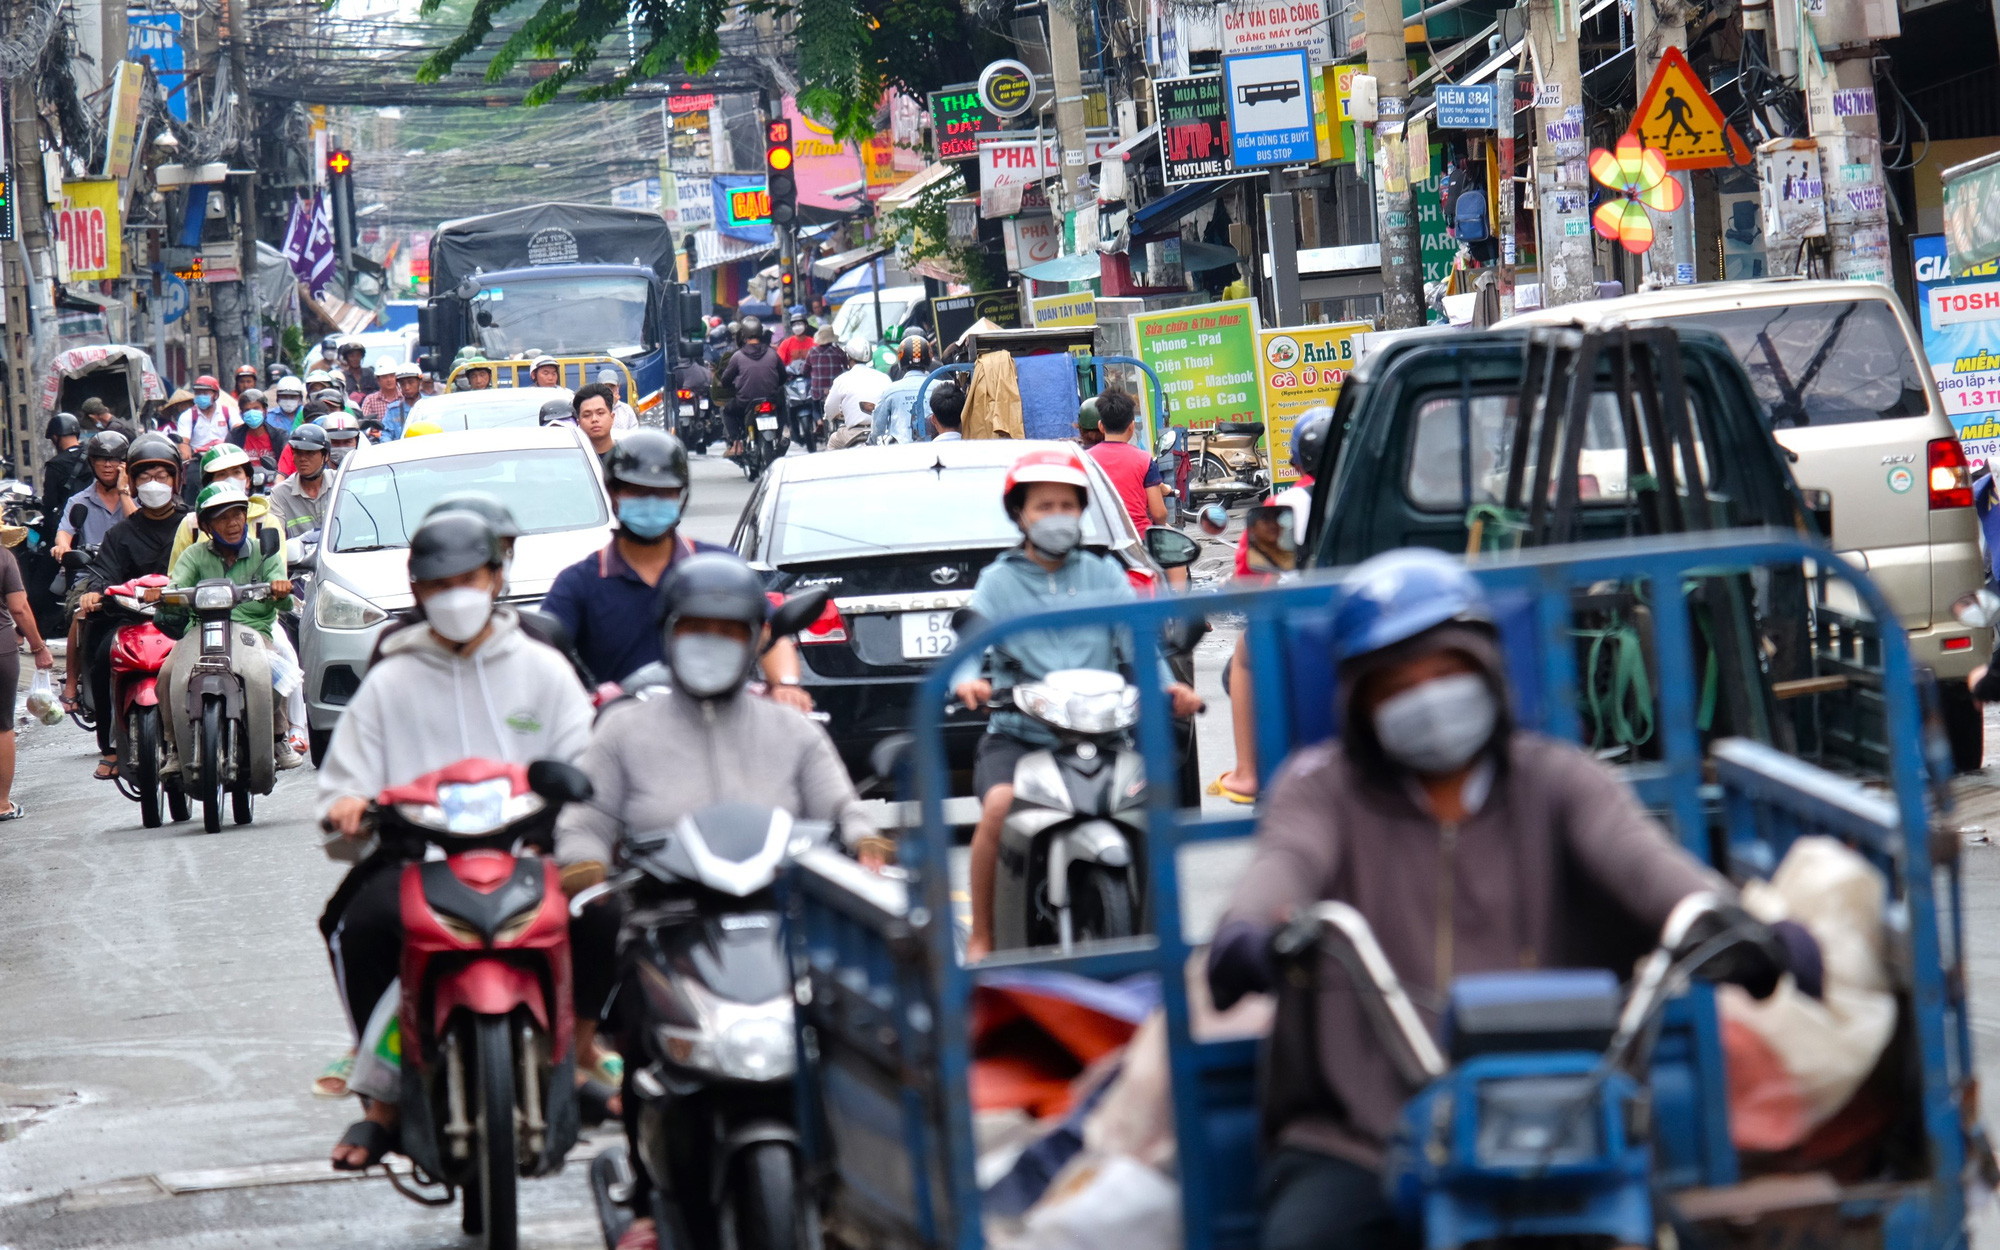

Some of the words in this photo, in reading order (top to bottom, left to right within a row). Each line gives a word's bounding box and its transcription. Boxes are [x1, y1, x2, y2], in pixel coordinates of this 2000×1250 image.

[1269, 8, 1287, 25] GIA
[1290, 2, 1320, 22] CÔNG
[1174, 87, 1197, 102] MUA
[1200, 83, 1220, 99] BÁN
[1440, 89, 1465, 105] HẺM
[1546, 85, 1560, 93] EDT
[1168, 105, 1194, 120] THAY
[1197, 103, 1220, 117] LINH
[770, 123, 788, 142] 20
[1167, 122, 1212, 161] LAPTOP
[1237, 133, 1256, 148] ĐIỂM
[1257, 133, 1278, 147] DỪNG
[1280, 133, 1289, 144] XE
[1291, 130, 1309, 143] BUÝT
[1256, 150, 1272, 161] BUS
[1273, 148, 1292, 159] STOP
[1174, 160, 1222, 177] HOTLINE:
[1037, 305, 1058, 322] QUÁN
[1059, 303, 1074, 318] TÂY
[1075, 302, 1094, 316] NAM
[1145, 322, 1163, 336] Sửa
[1152, 338, 1188, 354] Iphone
[1198, 332, 1222, 347] IPad
[1303, 341, 1337, 363] Anh
[1155, 359, 1182, 375] Điện
[1184, 354, 1214, 369] Thoại
[1162, 379, 1194, 394] aptop
[1205, 370, 1254, 388] Macbook
[1272, 370, 1297, 388] Gà
[1936, 378, 1964, 393] giao
[1966, 373, 1986, 389] lắp
[1186, 393, 1211, 410] Giá
[1217, 391, 1247, 406] Cao
[928, 614, 953, 633] 64
[916, 636, 952, 655] 132
